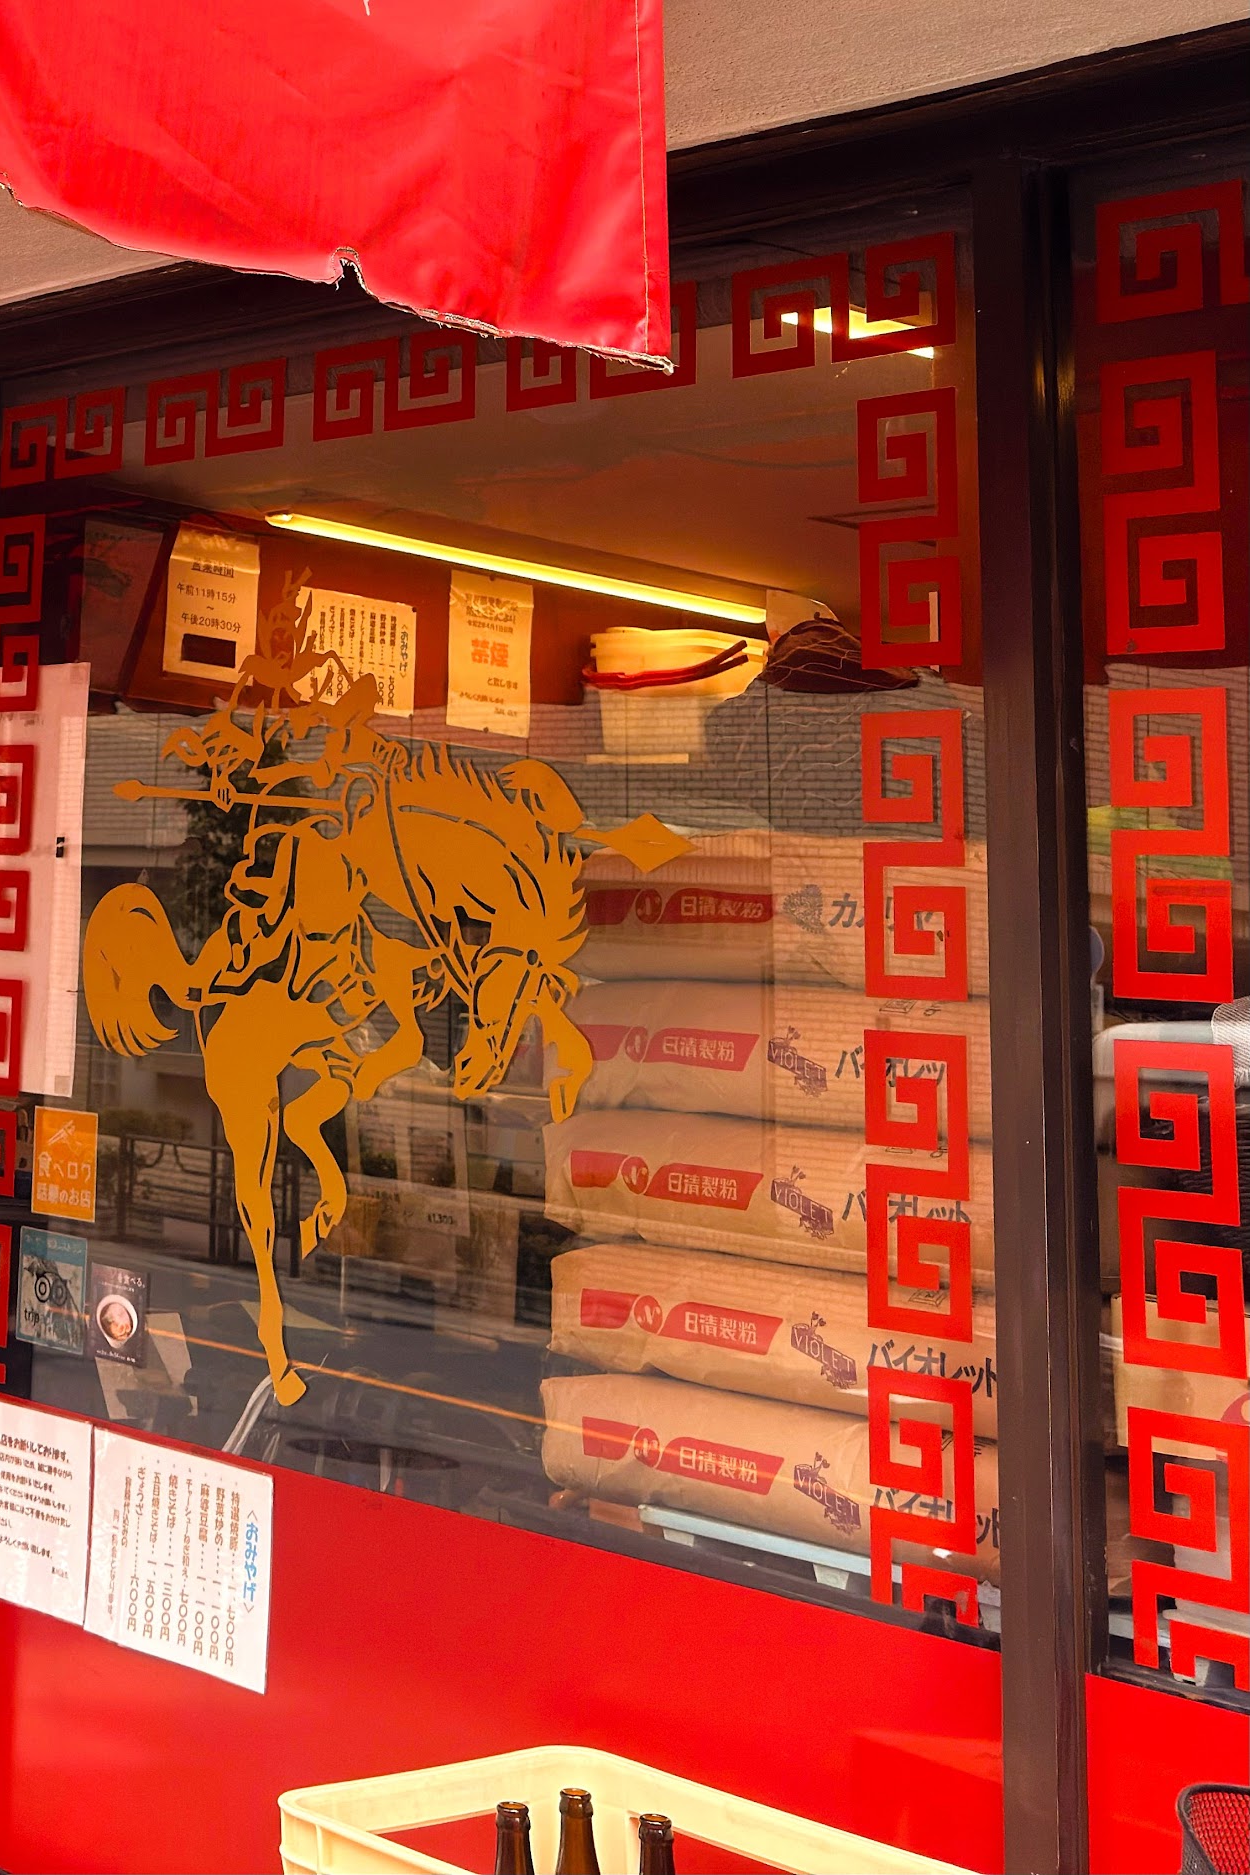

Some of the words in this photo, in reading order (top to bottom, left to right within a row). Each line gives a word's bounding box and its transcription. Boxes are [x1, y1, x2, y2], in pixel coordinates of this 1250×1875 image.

[177, 582, 236, 604] 午前11時15分
[181, 612, 242, 634] 午後20時30分
[680, 896, 764, 921] 日清製粉
[662, 1035, 735, 1063] 日清製粉
[770, 1041, 827, 1082] VIOLET
[37, 1150, 92, 1184] 食べログ
[668, 1173, 738, 1201] 日清製粉
[773, 1182, 833, 1224] VIOLET
[23, 1307, 40, 1327] trip
[684, 1311, 757, 1345] 日清製粉
[792, 1327, 856, 1374] VIOLET
[679, 1446, 758, 1485] 日清製粉
[796, 1469, 860, 1518] VIOLET
